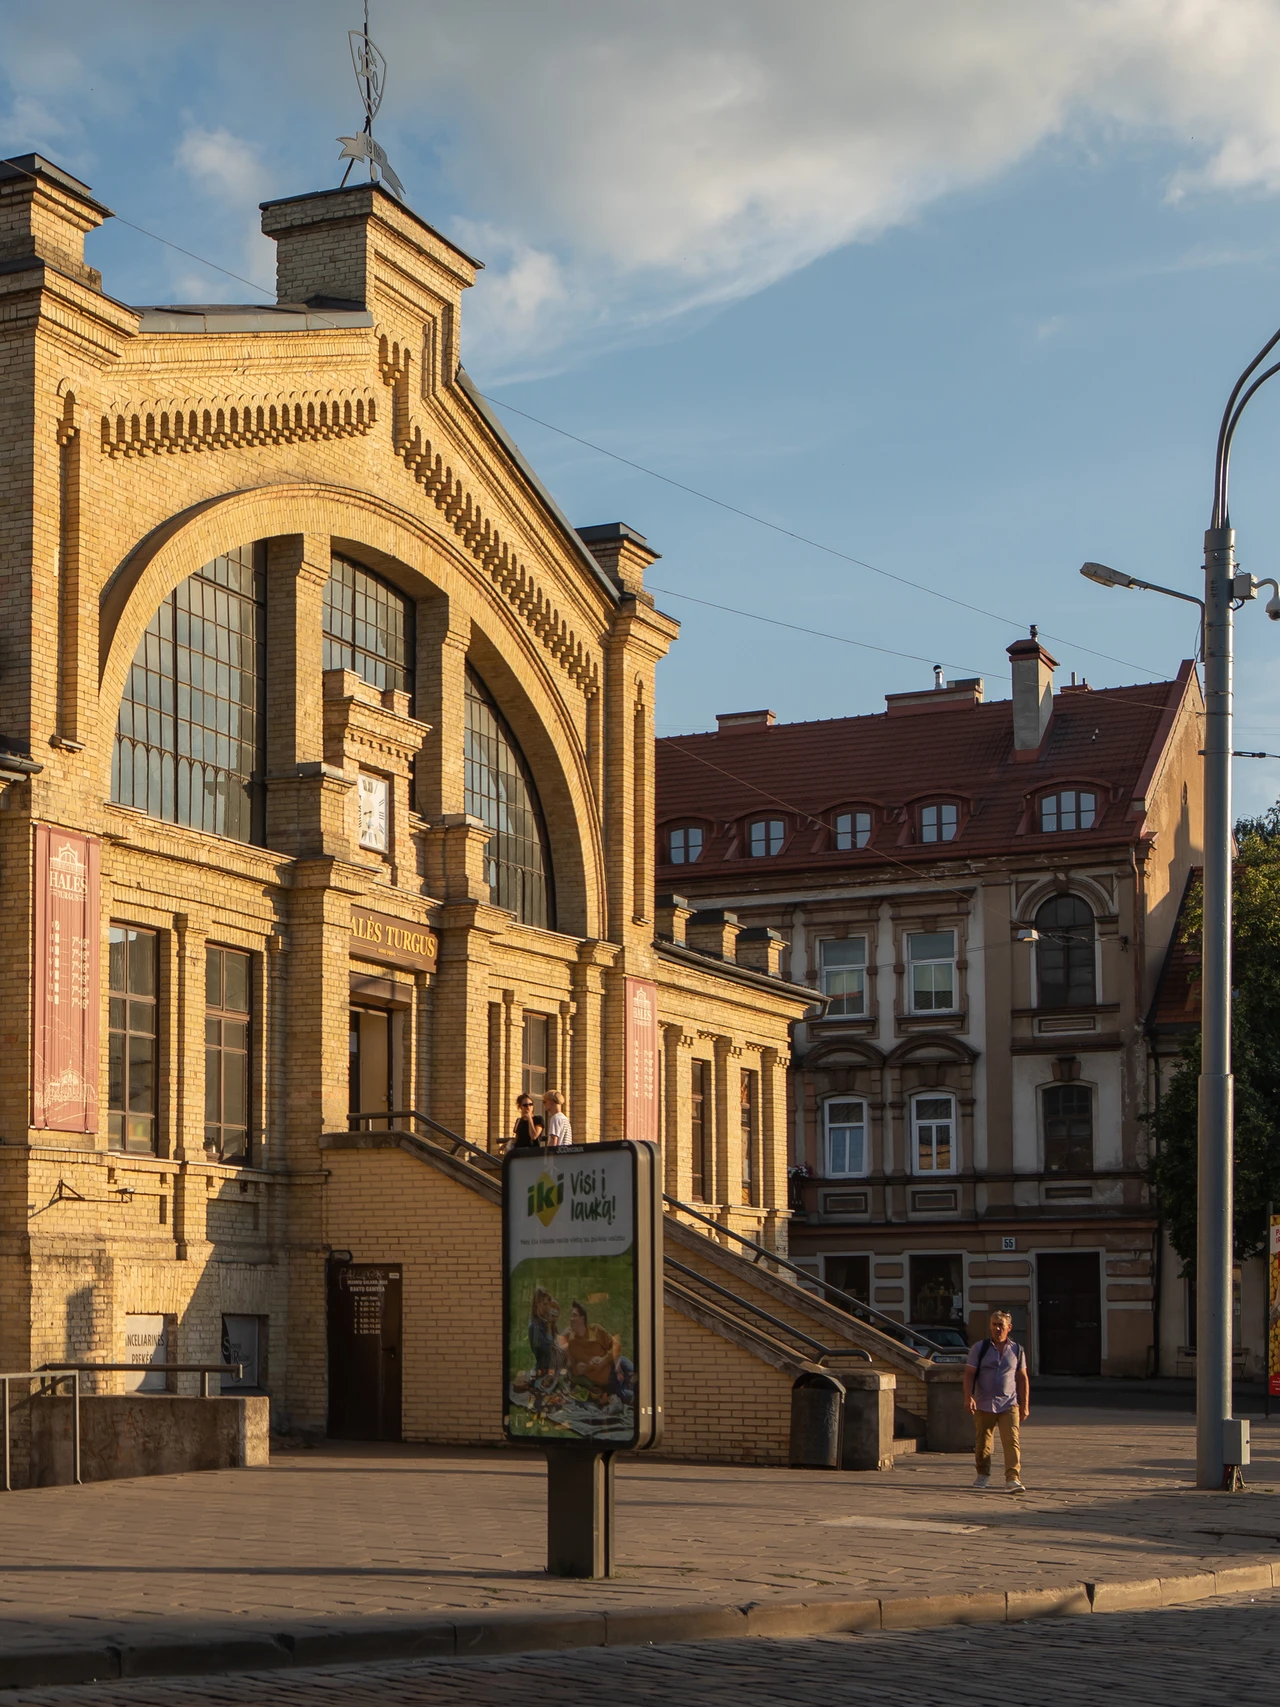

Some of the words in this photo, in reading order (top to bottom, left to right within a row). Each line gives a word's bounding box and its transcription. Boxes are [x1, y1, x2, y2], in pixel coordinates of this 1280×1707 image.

[385, 925, 436, 958] TURGUS
[527, 1172, 565, 1218] iki
[570, 1169, 596, 1197] Visi
[570, 1195, 616, 1226] lauką!
[1004, 1238, 1014, 1249] 55
